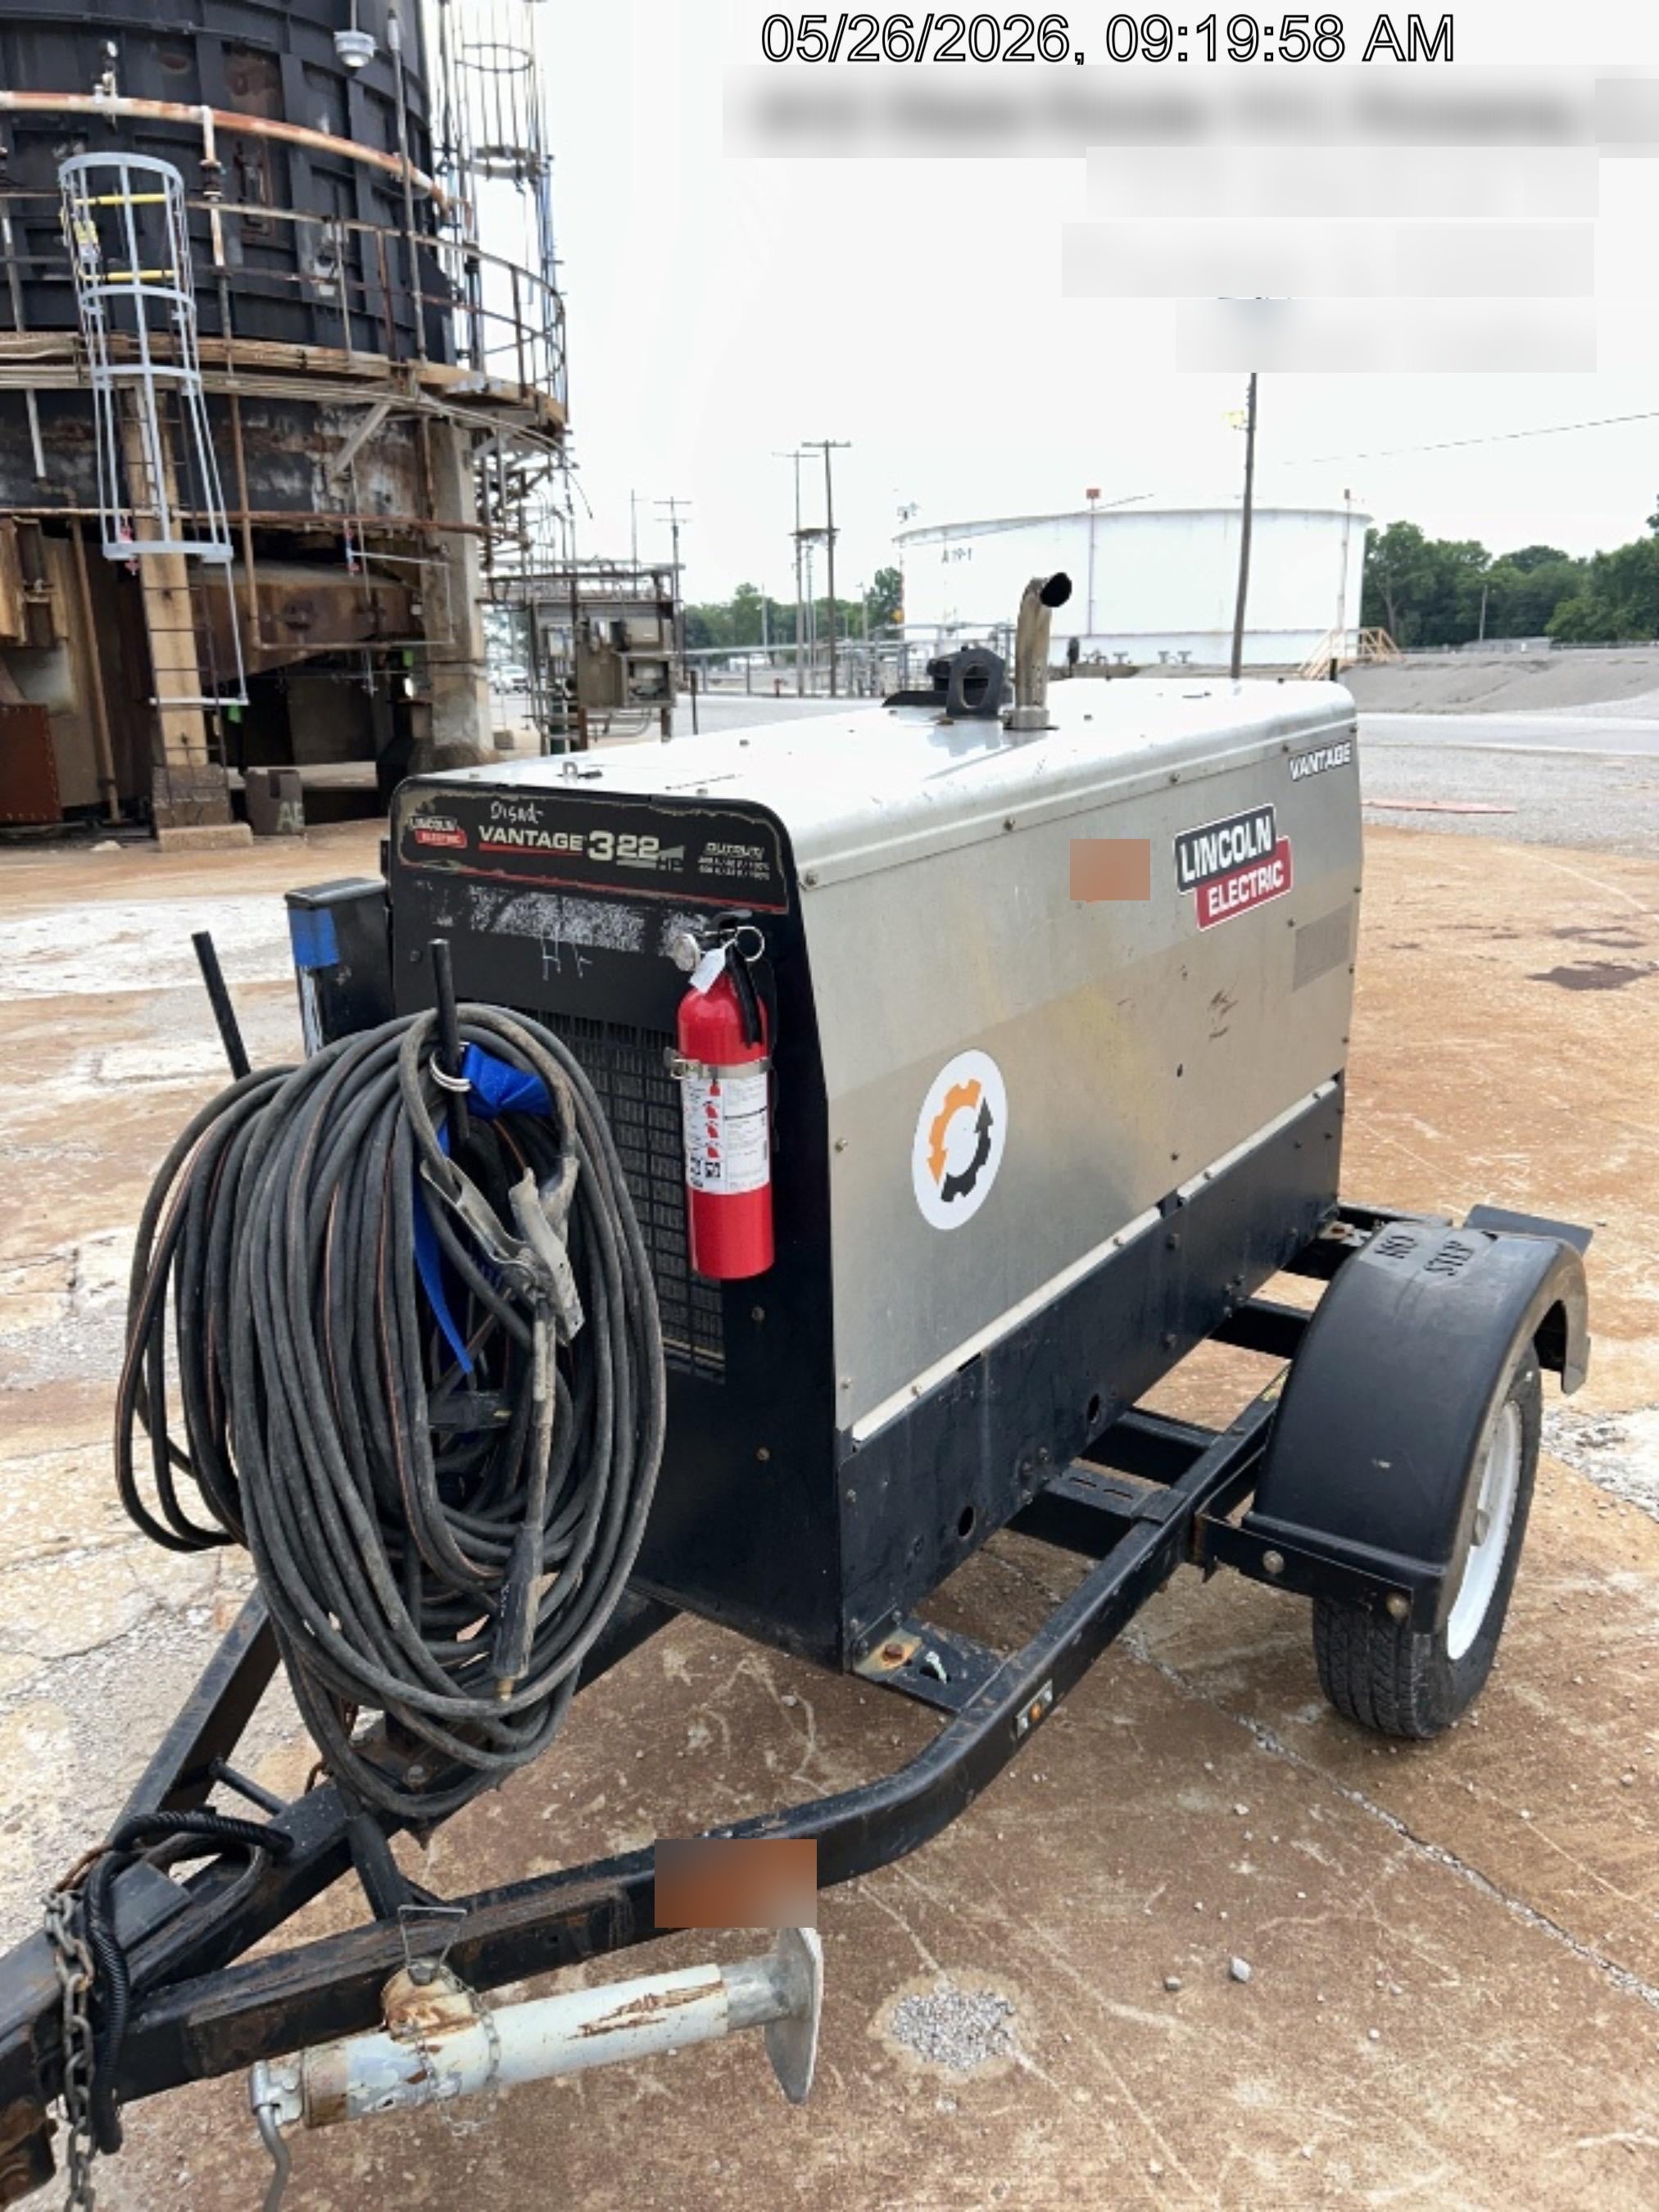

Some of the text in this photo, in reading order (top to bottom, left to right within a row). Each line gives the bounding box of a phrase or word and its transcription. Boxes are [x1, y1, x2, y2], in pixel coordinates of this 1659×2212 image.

[1290, 741, 1351, 780] VANTAGE
[478, 825, 660, 861] VANTAGE 322
[1180, 816, 1272, 882] LINCOLN
[1208, 860, 1285, 918] ELECTRIC
